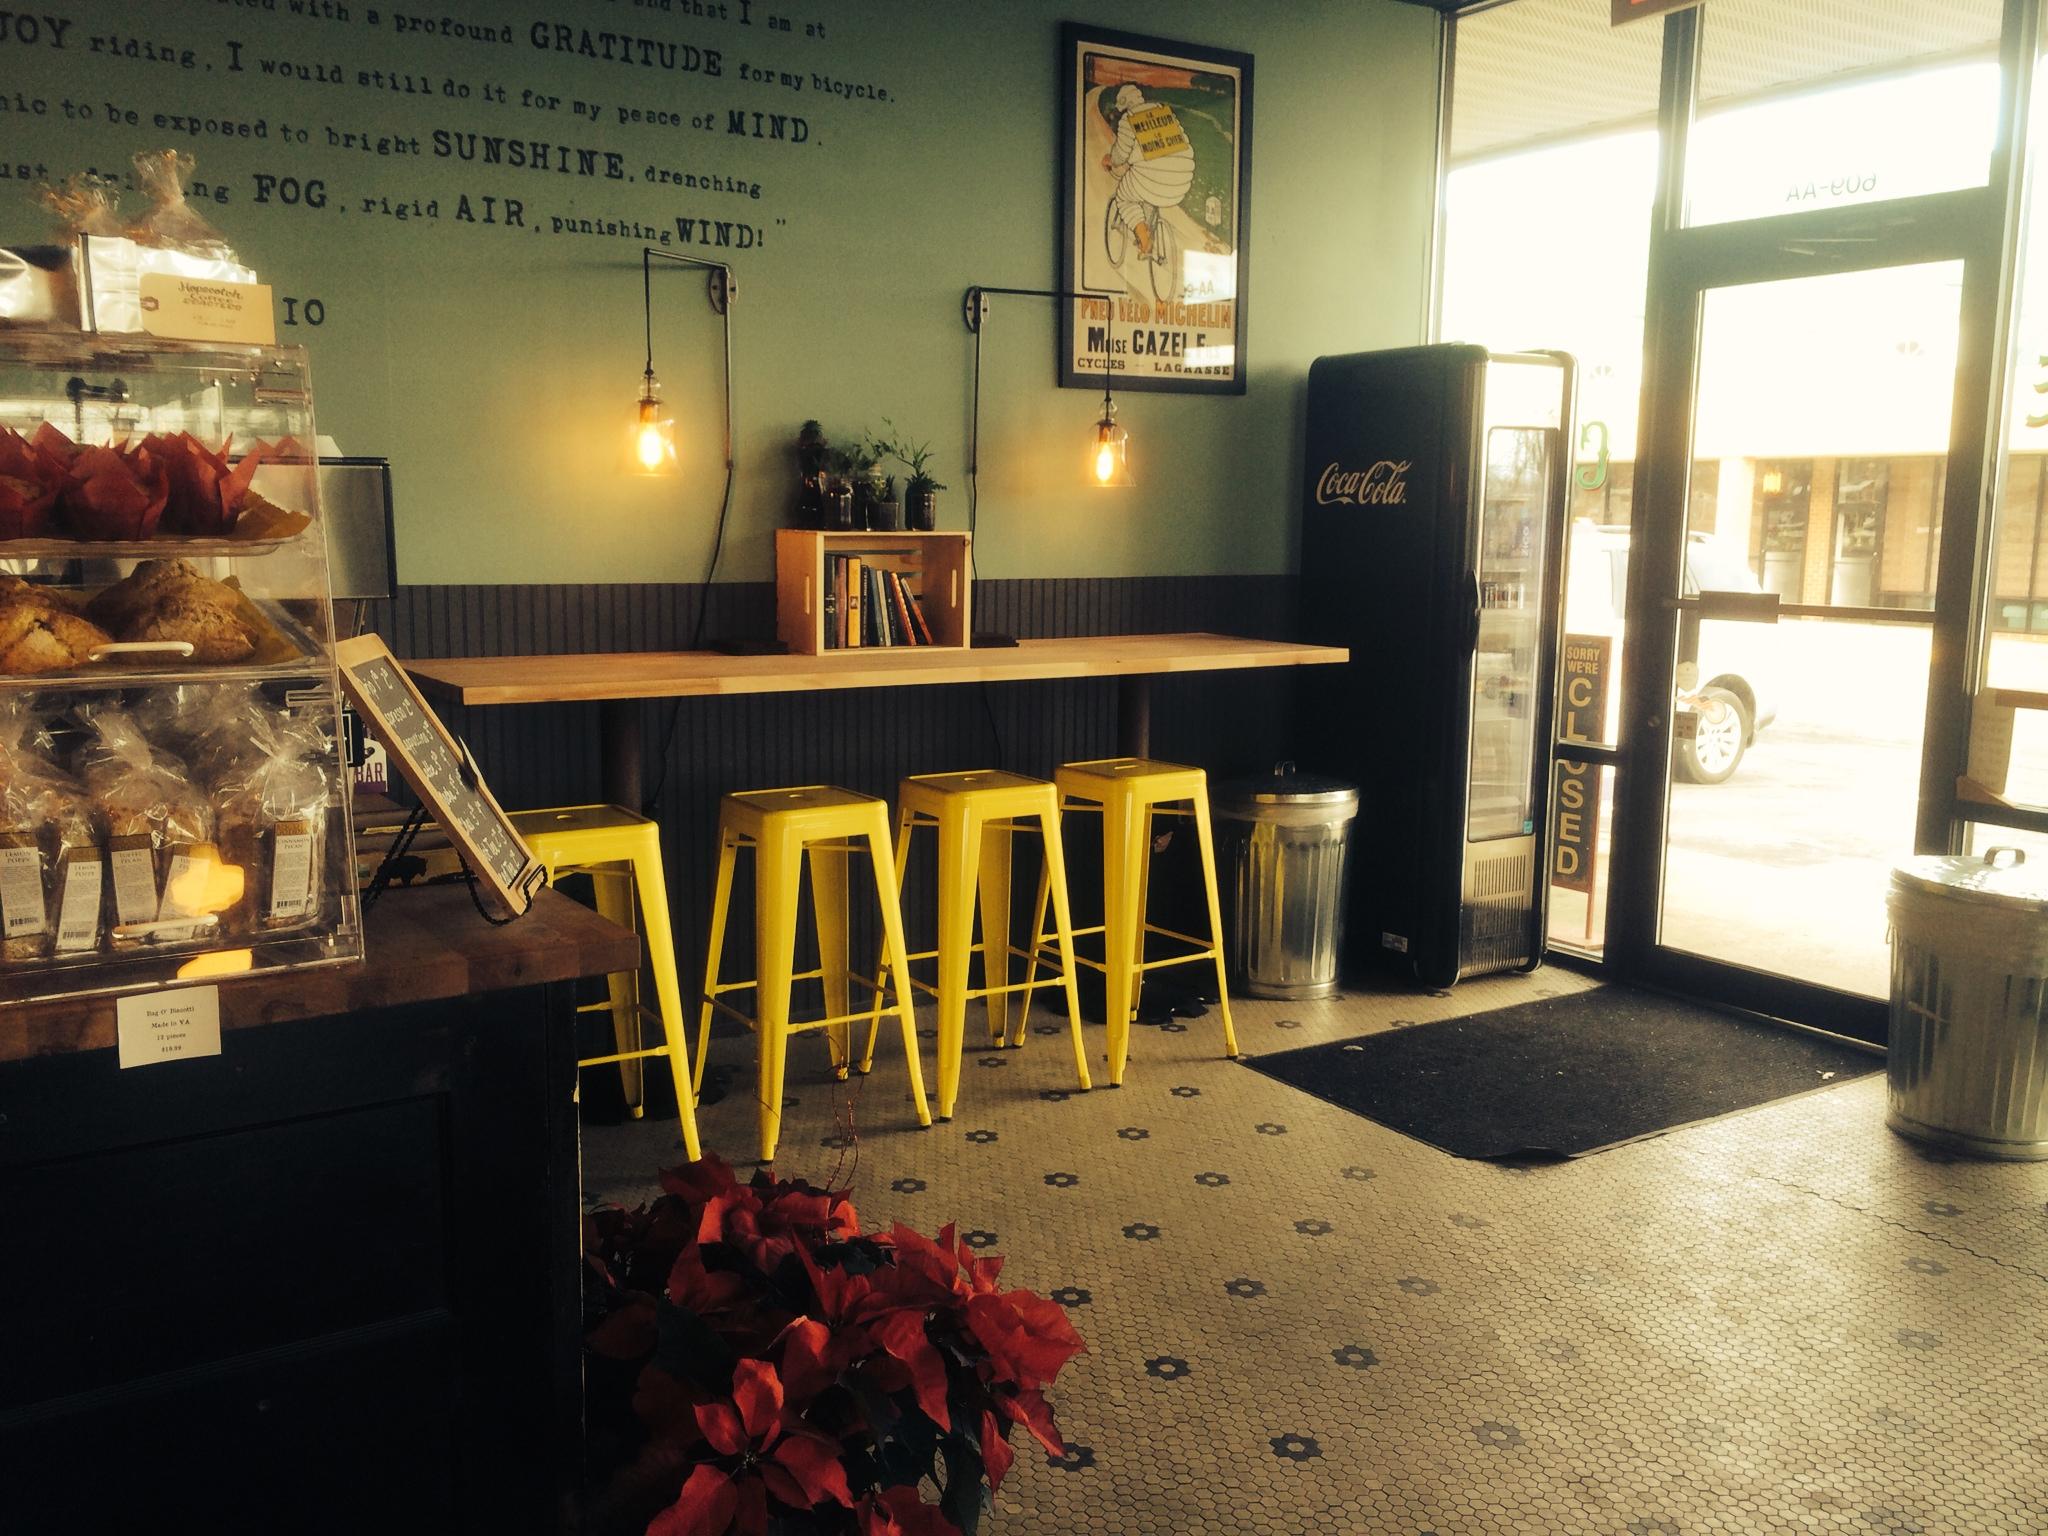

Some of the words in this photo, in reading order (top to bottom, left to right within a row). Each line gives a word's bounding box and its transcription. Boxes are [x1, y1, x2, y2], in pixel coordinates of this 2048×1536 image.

[681, 0, 727, 20] that
[739, 0, 751, 25] I
[768, 16, 791, 31] am
[806, 22, 825, 39] at
[289, 0, 349, 21] with
[367, 10, 379, 24] a
[394, 14, 513, 44] profound
[531, 18, 725, 77] GRATITUDE
[740, 63, 775, 83] for
[781, 73, 803, 91] my
[811, 73, 894, 102] bicycle.
[90, 36, 212, 71] riding,
[227, 41, 243, 71] I
[260, 60, 343, 83] would
[358, 71, 432, 94] still
[443, 78, 470, 98] do
[484, 84, 505, 103] it
[522, 89, 560, 110] for
[573, 101, 601, 121] my
[618, 107, 680, 126] peace
[692, 114, 714, 130] of
[727, 110, 821, 145] MIND.
[1134, 114, 1175, 133] MEILLEUR
[61, 99, 93, 119] to
[104, 103, 138, 125] be
[153, 114, 267, 138] exposed
[280, 124, 308, 143] to
[325, 127, 419, 155] bright
[433, 130, 634, 182] SUNSHINE,
[645, 166, 761, 199] drenching
[363, 197, 438, 220] rigid
[551, 217, 671, 246] punishing
[1155, 301, 1232, 328] MICHELIN
[1078, 358, 1126, 369] CYCLES
[1316, 459, 1413, 505] Coca-Cola
[1567, 646, 1600, 662] SORRY
[1567, 661, 1600, 675] WE'RE
[353, 762, 384, 784] BAR
